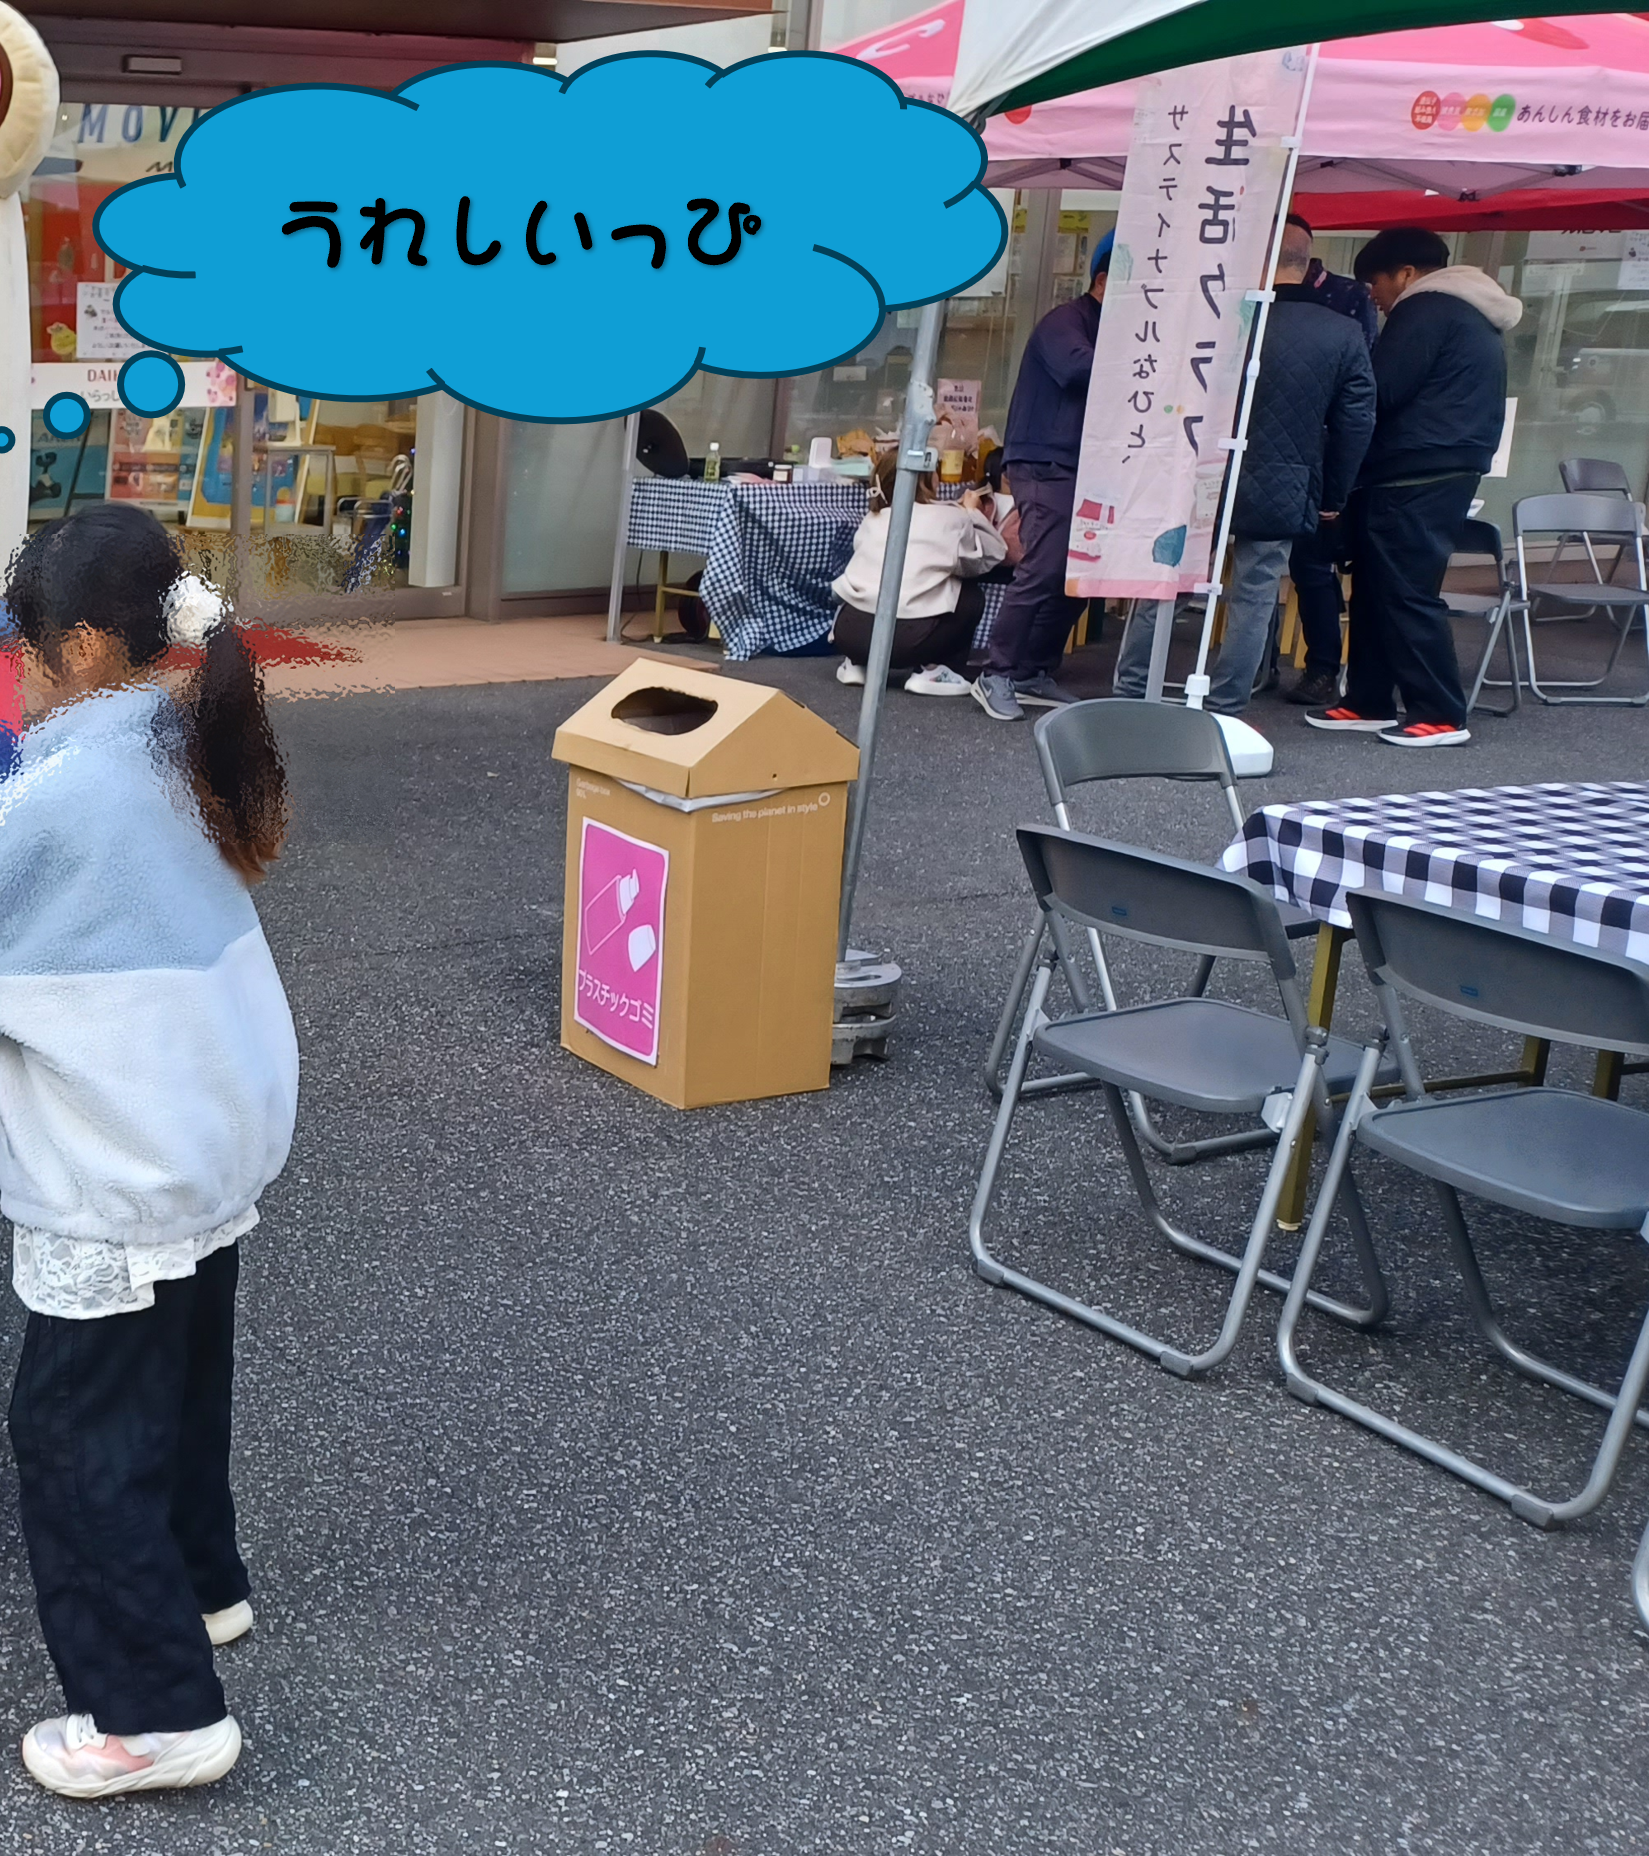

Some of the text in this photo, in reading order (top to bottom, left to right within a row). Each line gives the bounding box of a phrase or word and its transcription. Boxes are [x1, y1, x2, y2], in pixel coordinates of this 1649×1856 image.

[1517, 104, 1649, 131] あんしん食材をお届
[712, 801, 819, 823] Saving the planet in style
[579, 969, 654, 1030] プラスチックゴミ
